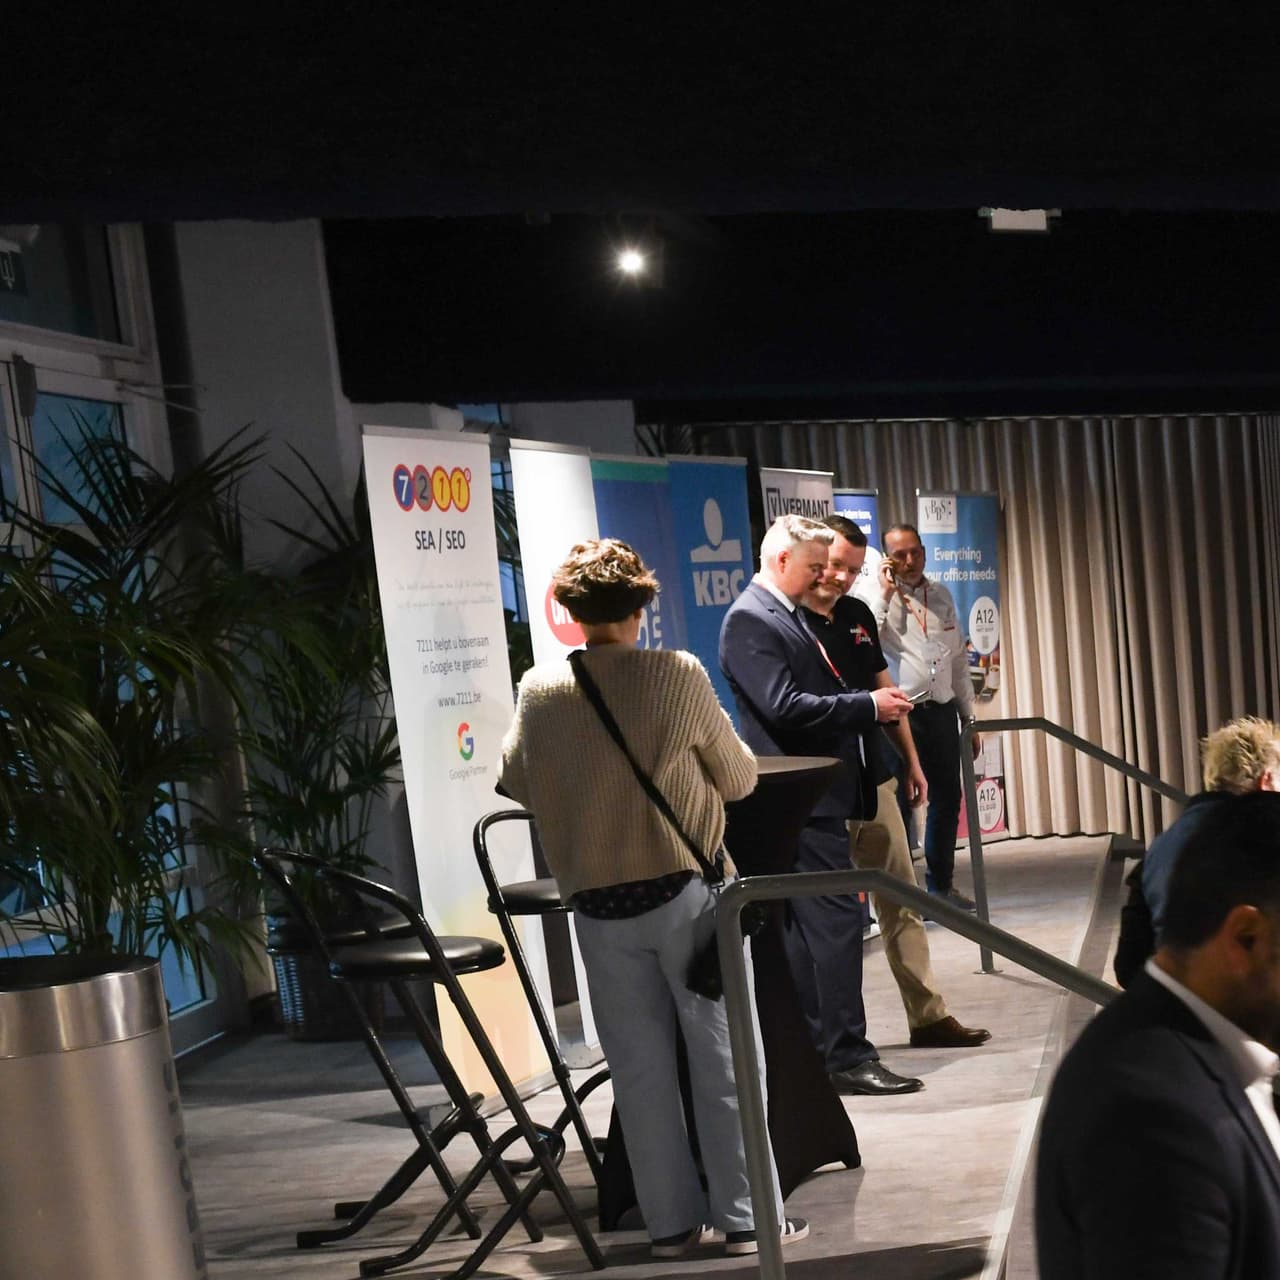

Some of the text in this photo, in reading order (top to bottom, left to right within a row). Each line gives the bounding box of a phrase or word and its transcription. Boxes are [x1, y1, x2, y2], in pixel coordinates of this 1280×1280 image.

[397, 470, 464, 506] 7211
[782, 498, 829, 518] VERMANT
[415, 530, 436, 550] SEA
[445, 530, 466, 550] SEO
[934, 546, 982, 564] Everything
[925, 567, 996, 582] our office needs
[692, 569, 745, 606] KBC
[976, 609, 994, 624] A12
[416, 639, 433, 653] 7211
[434, 636, 452, 653] helpt
[459, 635, 489, 649] bovenaan
[430, 660, 453, 676] Google
[438, 691, 481, 707] www.7211.be
[980, 788, 996, 801] A12
